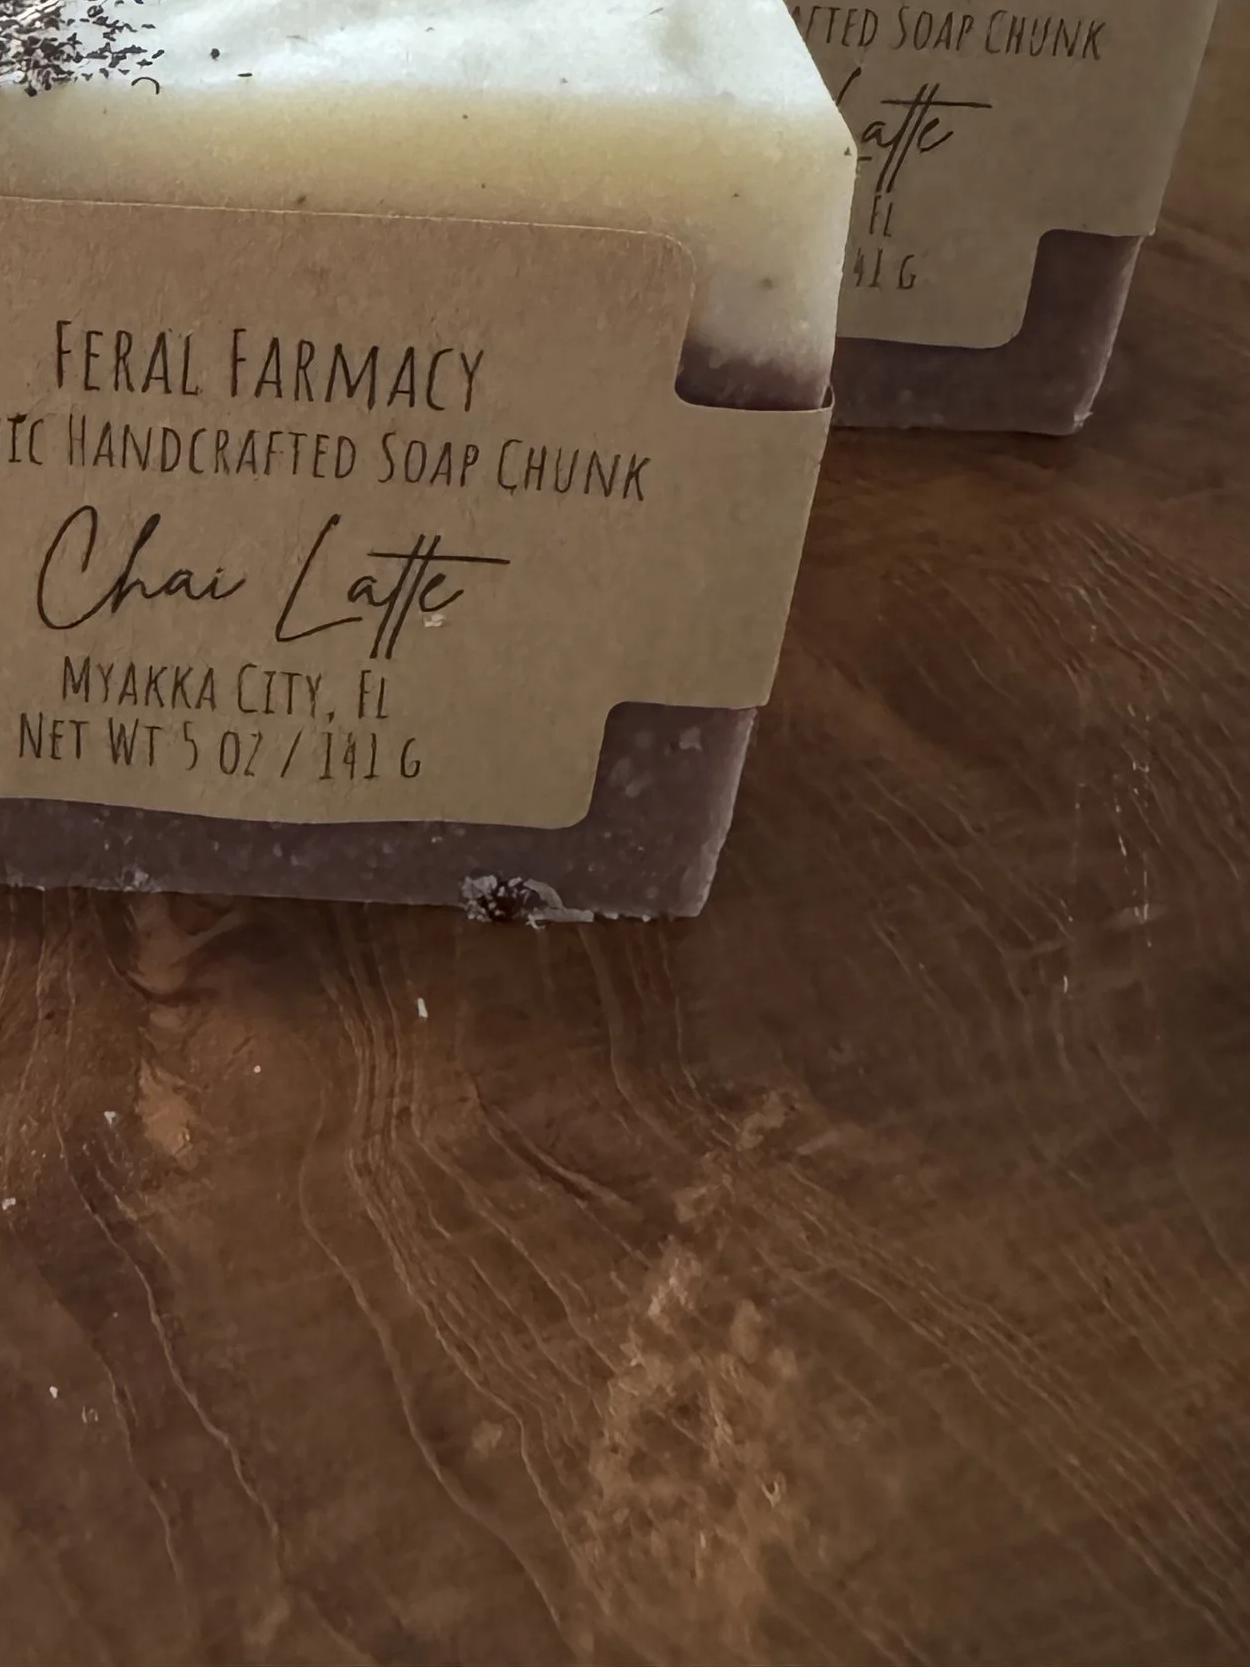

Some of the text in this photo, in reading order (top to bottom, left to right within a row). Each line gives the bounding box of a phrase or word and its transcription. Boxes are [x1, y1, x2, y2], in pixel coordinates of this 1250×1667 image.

[893, 5, 975, 52] SOAP
[984, 9, 1106, 61] CHUNK
[54, 319, 485, 413] FERAL FARMACY
[67, 412, 357, 480] HANDCRAFTED
[377, 429, 480, 488] SOAP
[496, 438, 652, 503] CHUNK
[35, 504, 512, 661] Chai Latte
[61, 655, 218, 712] MYAKKA
[357, 668, 389, 721] FL
[18, 711, 90, 761] NET
[107, 716, 164, 768] WT
[182, 719, 200, 772] 5
[279, 730, 303, 779] /
[318, 731, 380, 782] 141
[399, 737, 422, 780] G
